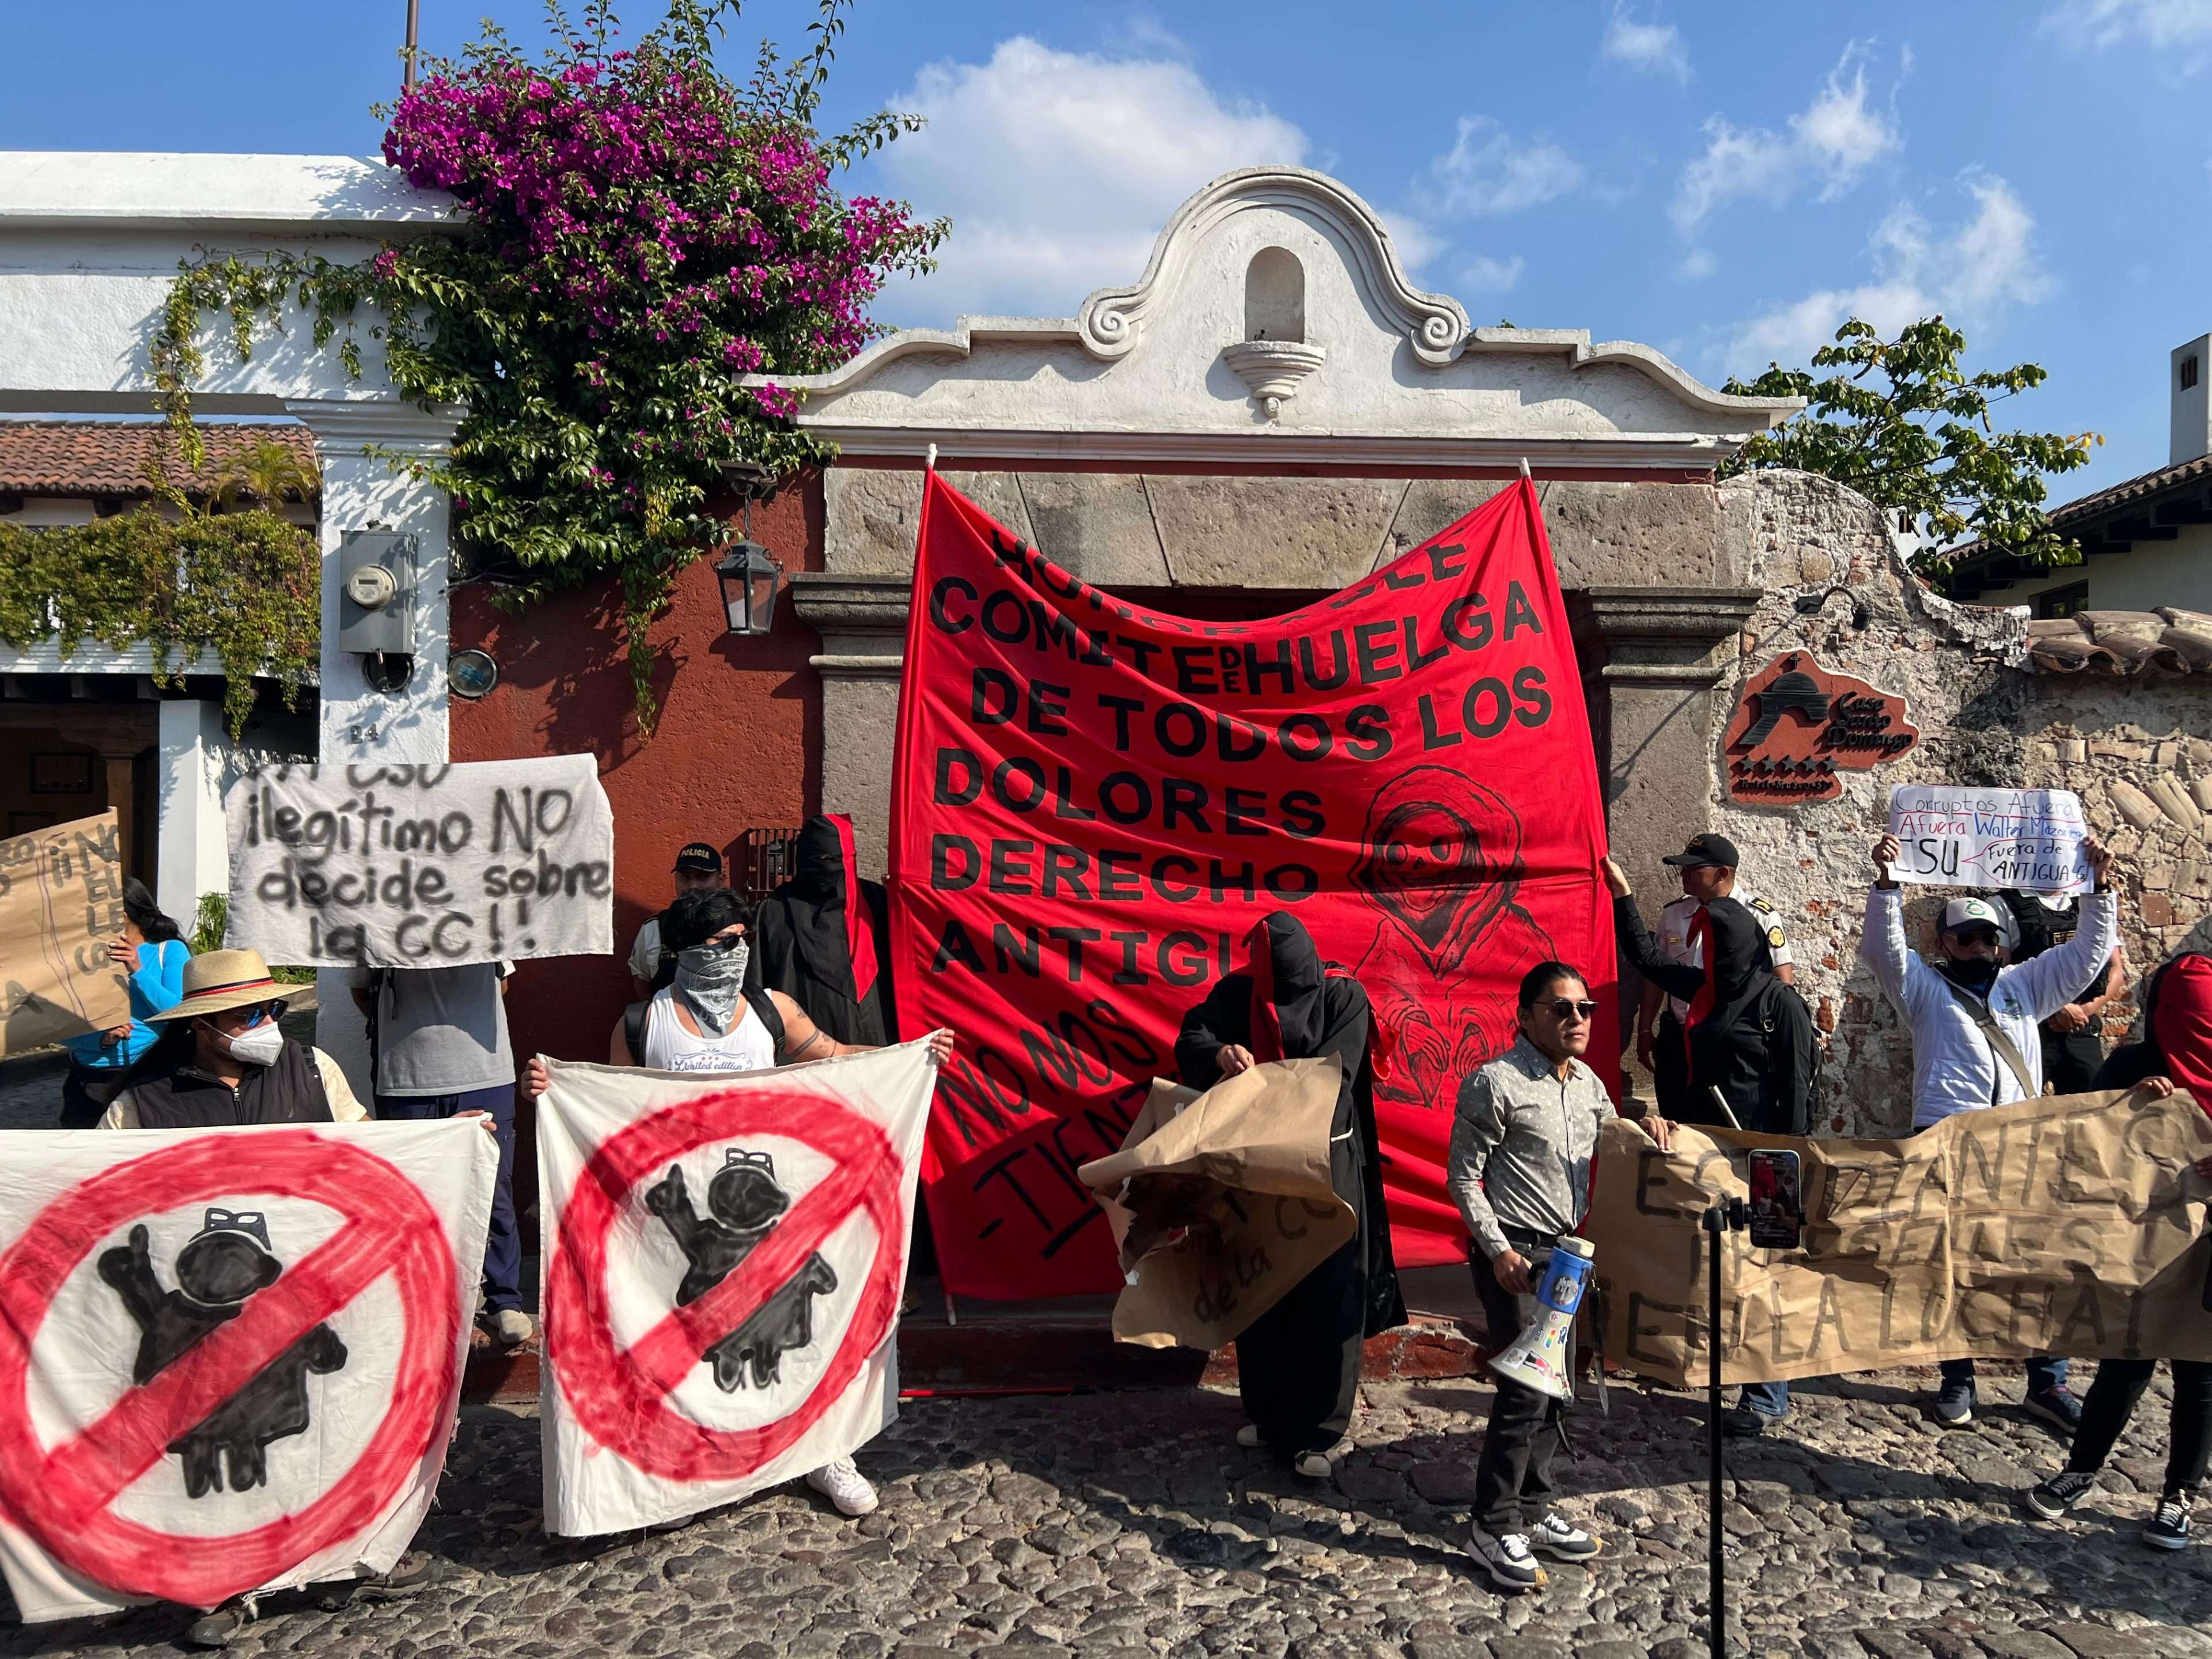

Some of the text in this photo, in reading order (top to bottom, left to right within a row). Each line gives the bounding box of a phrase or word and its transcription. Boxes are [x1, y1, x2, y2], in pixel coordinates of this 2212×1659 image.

[929, 577, 1218, 695] COMITE
[1244, 580, 1544, 695] HUELGA
[350, 724, 379, 744] 24
[971, 665, 1552, 763] DE TODOS LOS
[490, 787, 572, 853] NO
[933, 747, 1325, 839] DOLORES
[1900, 815, 1966, 836] Afuera
[1975, 812, 2024, 838] Walter
[257, 849, 612, 911] decide sobre
[931, 833, 1320, 902] DERECHO
[1992, 860, 2069, 881] ANTIGUA
[2043, 839, 2062, 855] de
[310, 916, 367, 960] la
[931, 920, 1233, 987] ANTIGU
[938, 999, 1158, 1147] NO NOS
[1770, 1275, 1851, 1365] LA
